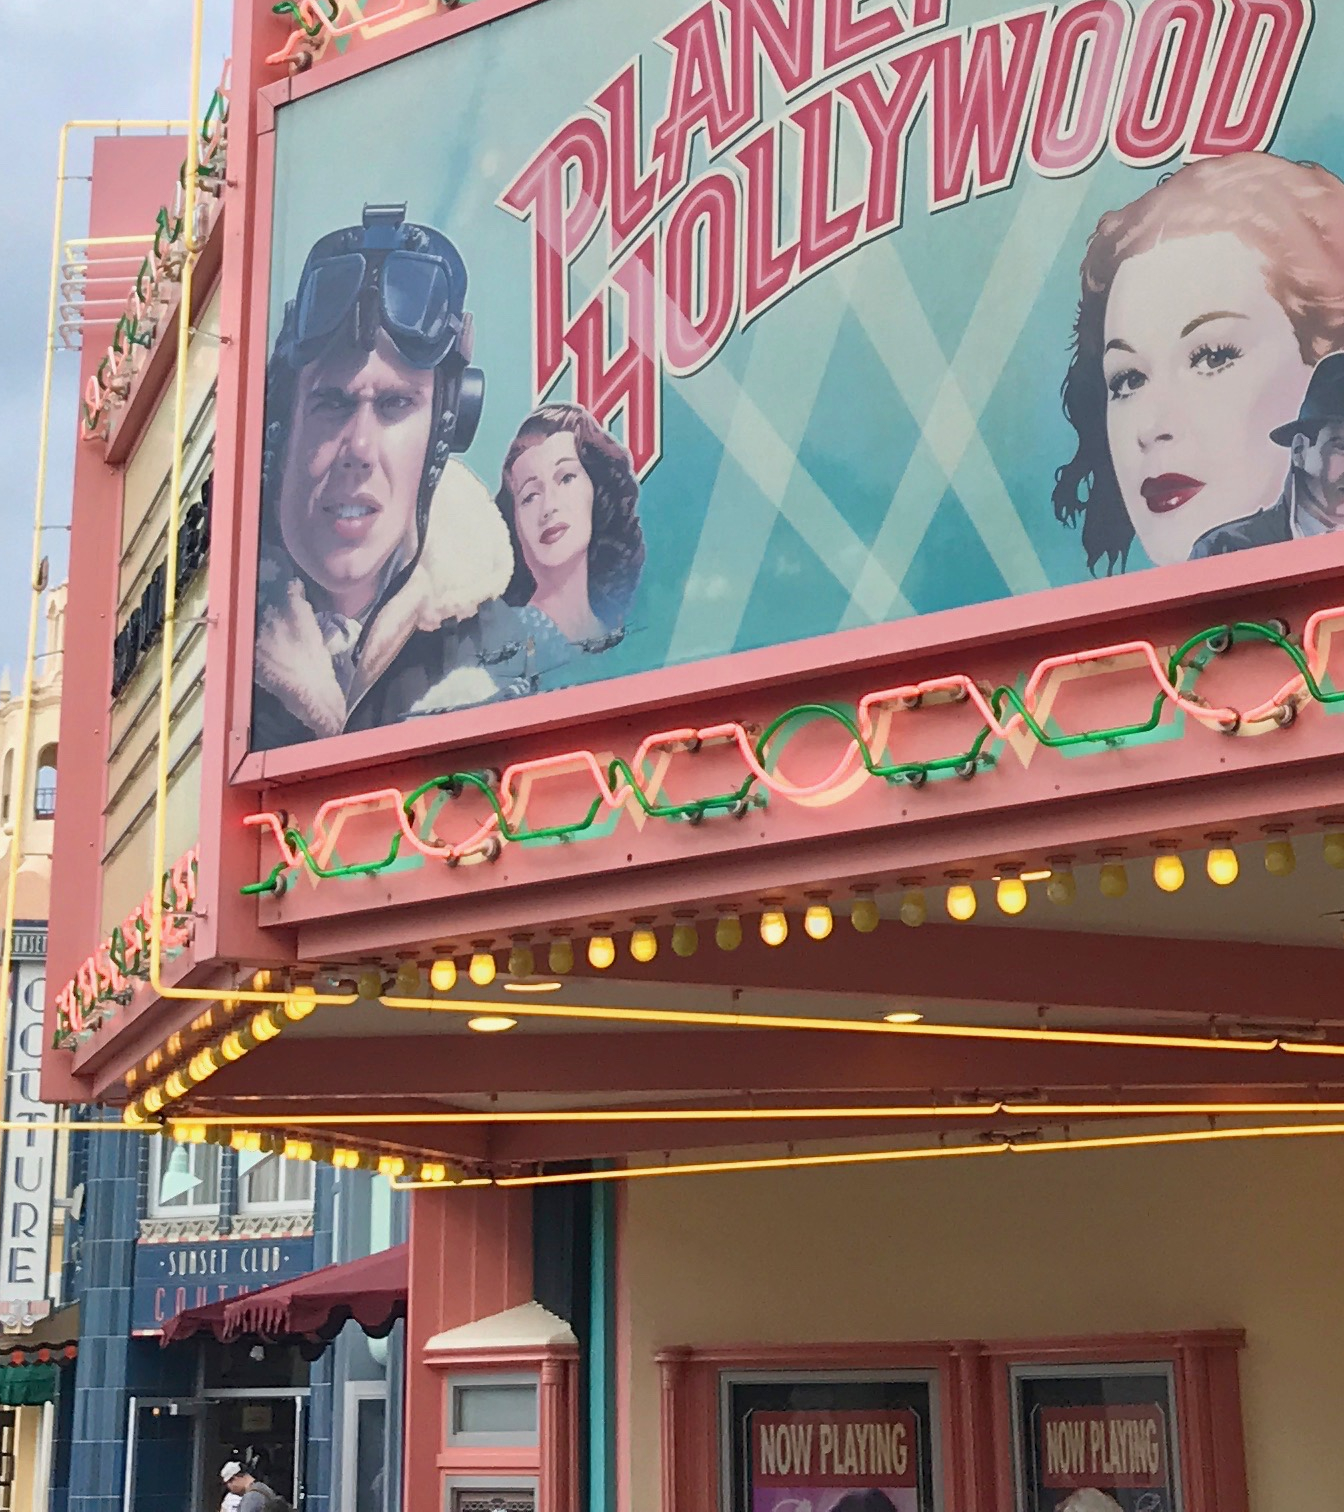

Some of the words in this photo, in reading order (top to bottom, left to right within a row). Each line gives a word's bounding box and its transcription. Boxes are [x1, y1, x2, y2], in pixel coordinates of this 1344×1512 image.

[14, 935, 47, 953] UNSET
[7, 977, 47, 1284] COUTURE
[168, 1249, 227, 1276] SUNSET
[240, 1246, 280, 1273] CLUB
[759, 1423, 814, 1476] NOW
[819, 1422, 908, 1476] PLAYING
[1045, 1420, 1086, 1474] NOW
[1090, 1418, 1158, 1475] PLAYING
